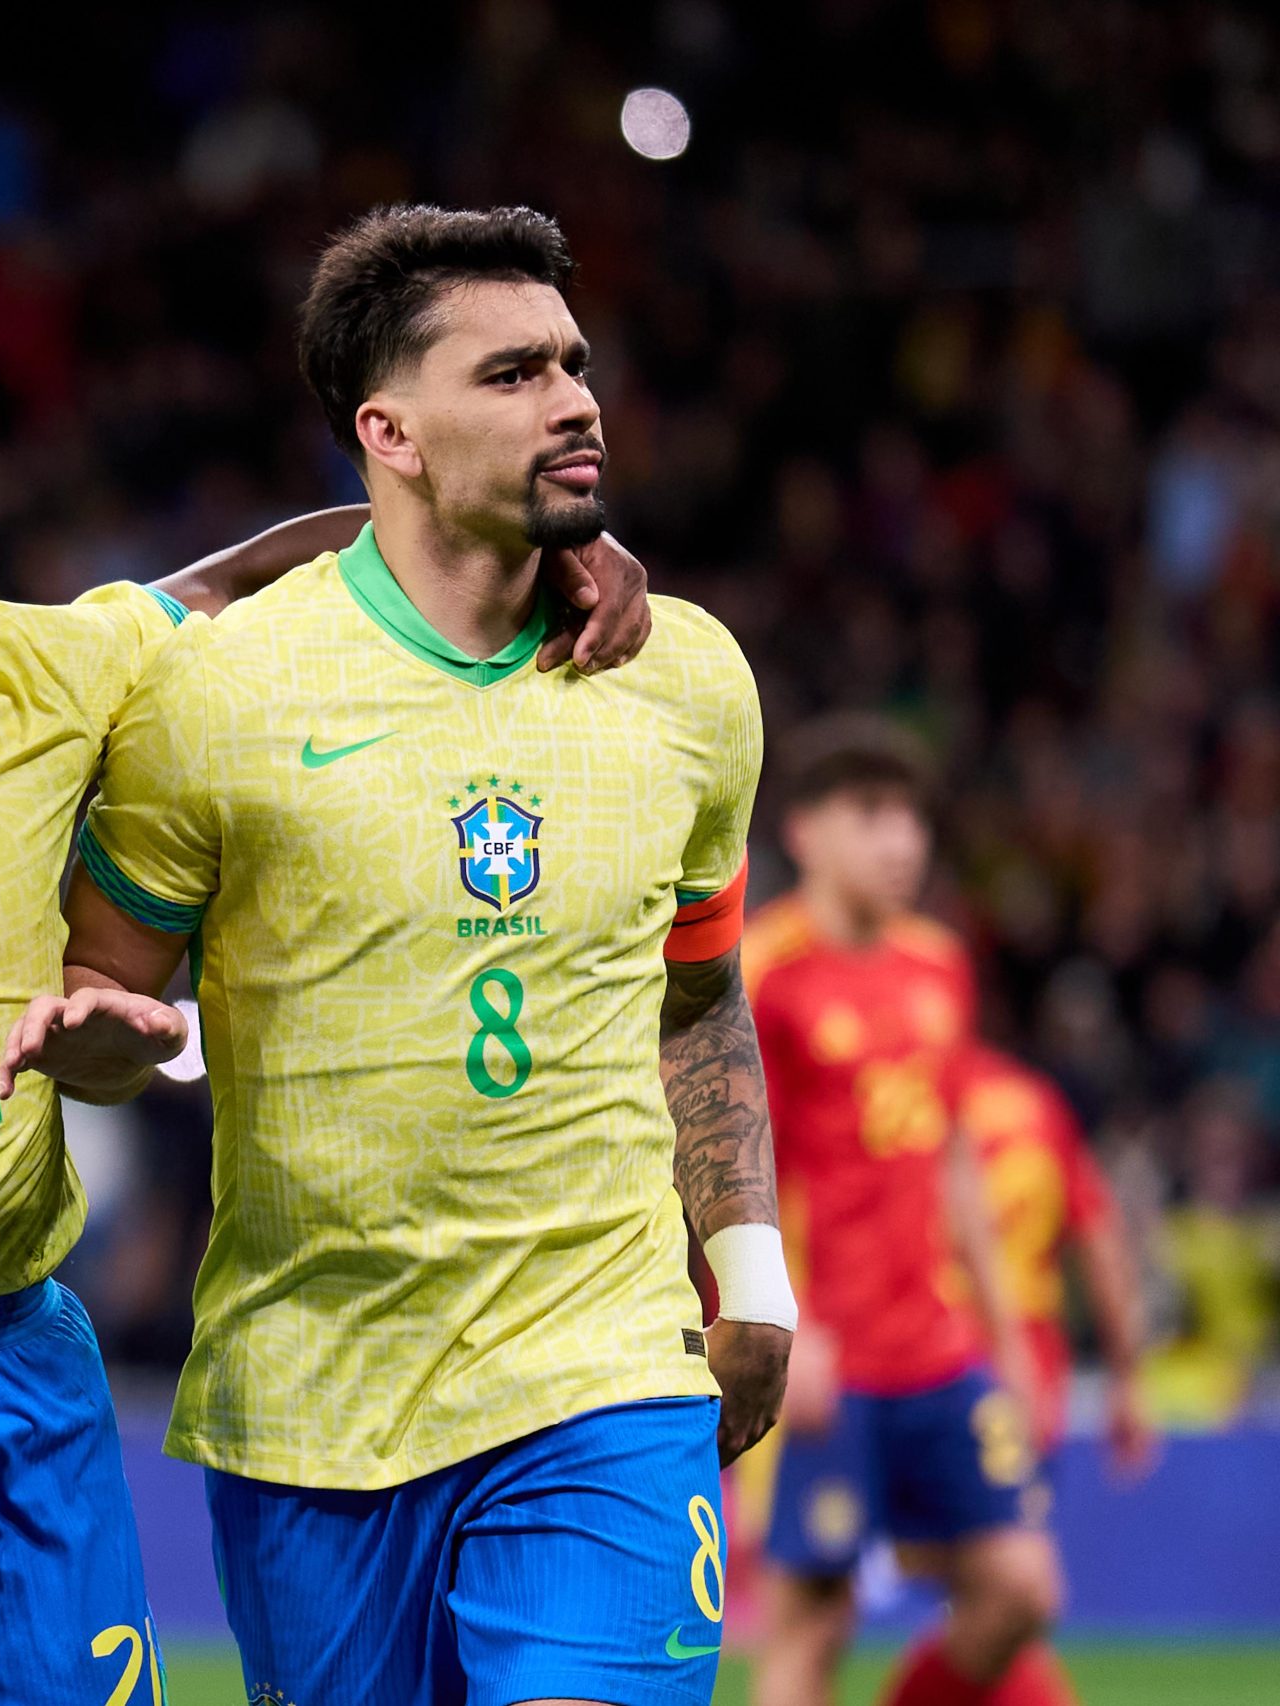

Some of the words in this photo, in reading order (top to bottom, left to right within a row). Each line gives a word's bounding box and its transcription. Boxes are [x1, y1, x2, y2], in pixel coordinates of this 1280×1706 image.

[483, 842, 515, 856] CBF
[457, 916, 547, 938] BRASIL
[466, 968, 532, 1099] 8
[688, 1495, 724, 1623] 8
